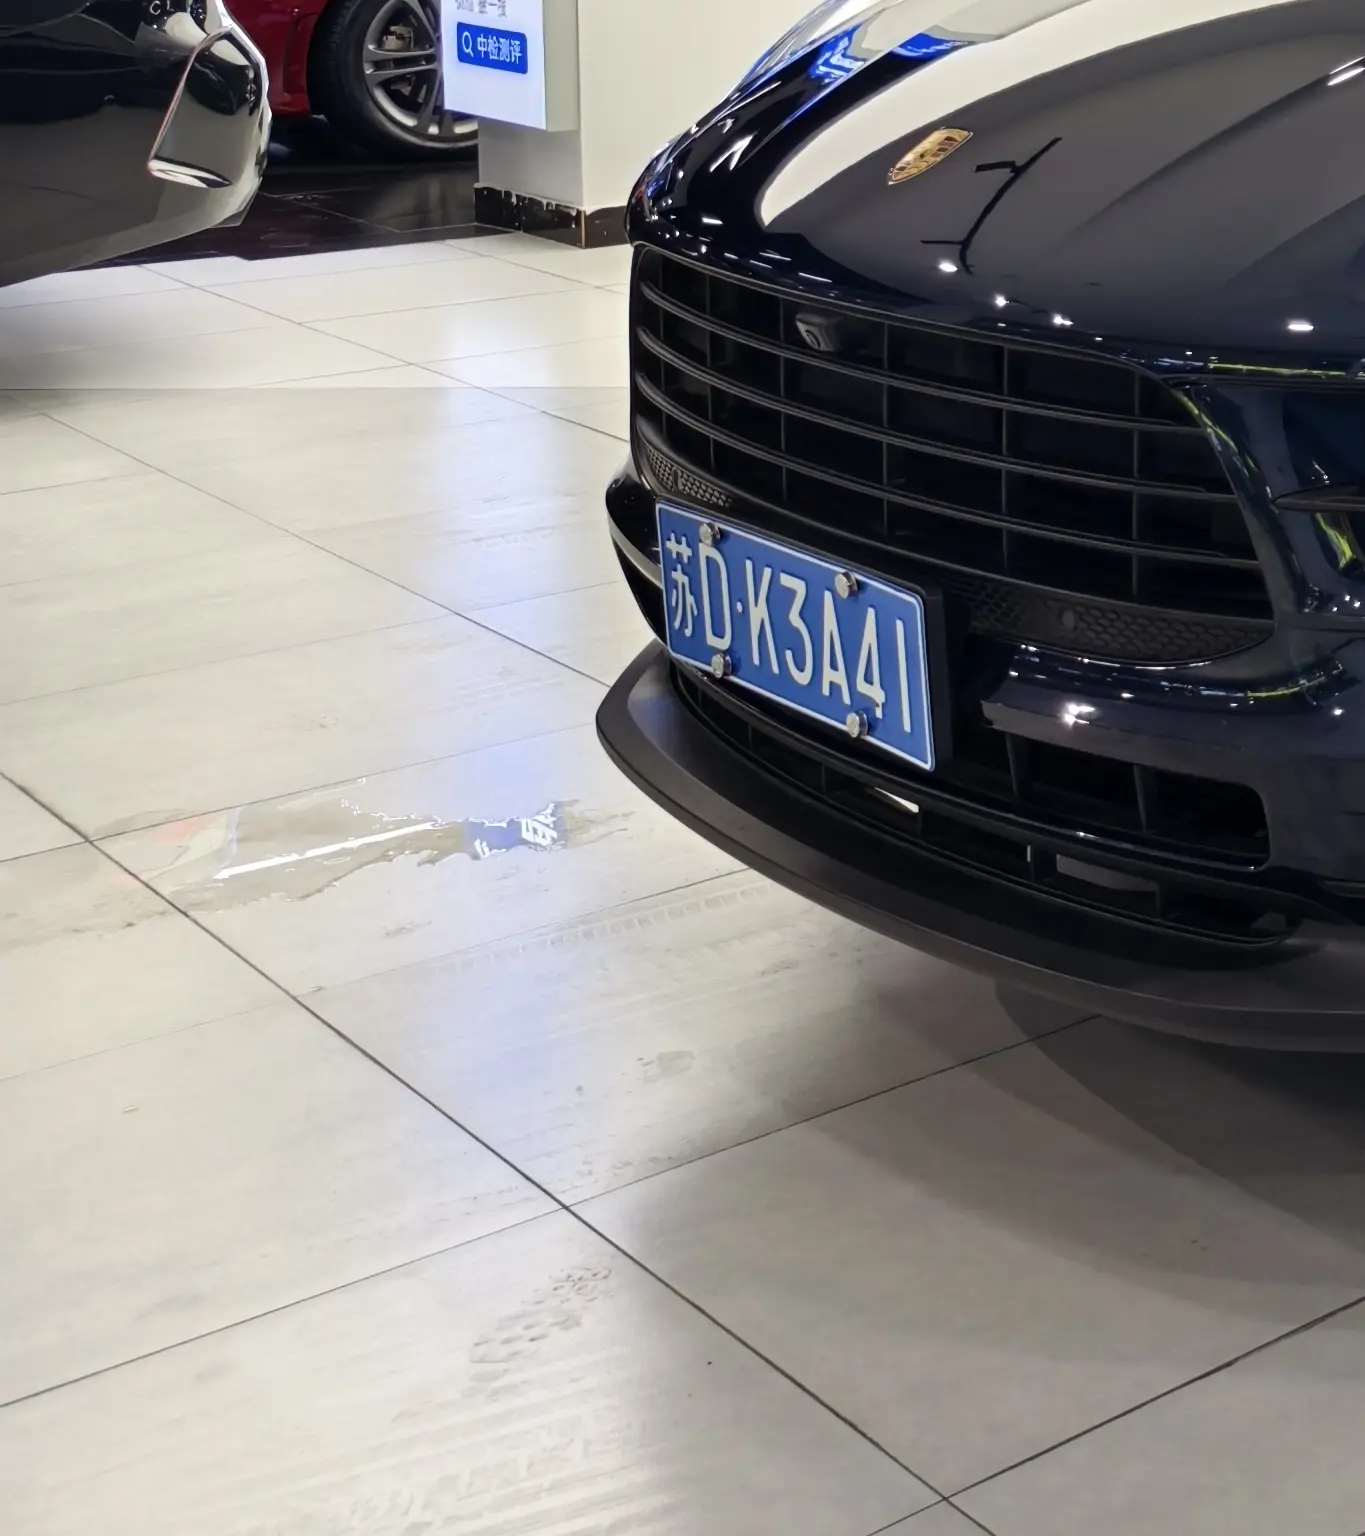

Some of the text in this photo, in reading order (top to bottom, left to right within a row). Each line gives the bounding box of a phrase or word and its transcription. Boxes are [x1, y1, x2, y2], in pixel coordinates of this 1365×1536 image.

[476, 33, 522, 64] 中检测评
[665, 532, 912, 733] 苏D·K3A41
